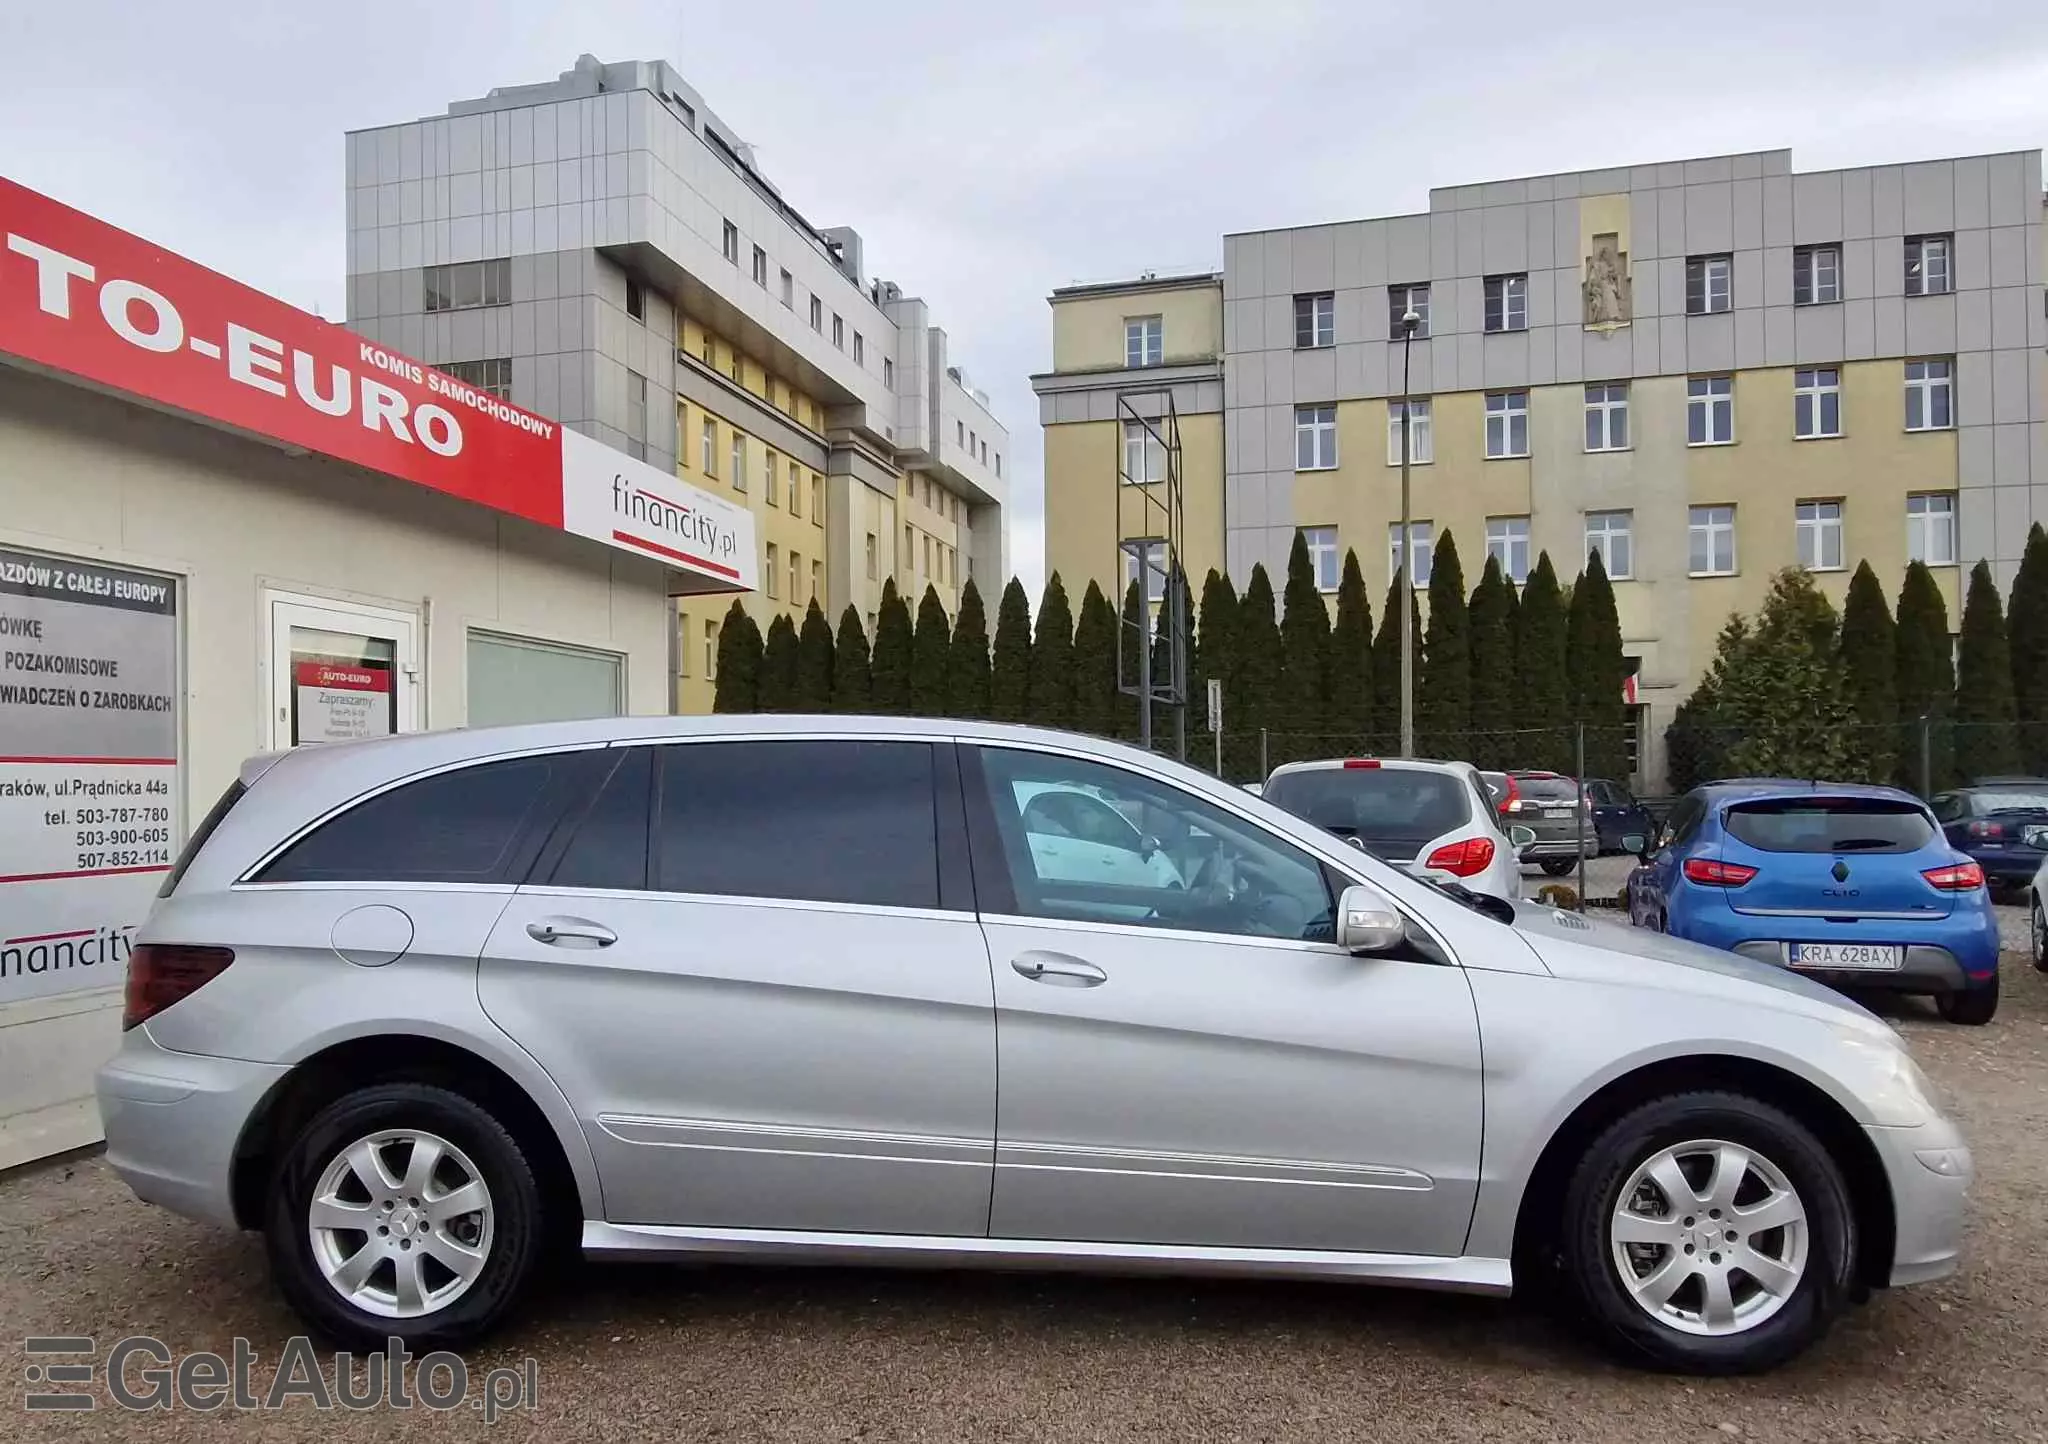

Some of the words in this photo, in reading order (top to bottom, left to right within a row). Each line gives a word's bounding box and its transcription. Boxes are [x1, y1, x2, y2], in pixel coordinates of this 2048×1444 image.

[8, 232, 463, 456] TO-EURO
[360, 343, 422, 385] KOMIS
[428, 370, 552, 440] SAMOCHODOWY
[613, 474, 736, 558] financity.pl
[54, 570, 63, 589] Z
[67, 572, 111, 596] CAŁEJ
[115, 580, 167, 604] EUROPY
[5, 651, 118, 677] POZAKOMISOWE
[323, 671, 372, 684] AUTO-EURO
[80, 691, 90, 707] O
[94, 691, 171, 712] ZAROBKACH
[0, 779, 50, 798] raków,
[55, 779, 142, 800] ul.Prądnicka
[146, 780, 168, 795] 44a
[45, 810, 70, 825] tel.
[76, 807, 169, 824] 503-787-780
[76, 828, 169, 846] 503-900-605
[78, 849, 169, 868] 507-852-114
[1822, 889, 1860, 897] CLIO
[1800, 946, 1832, 961] KRA
[1840, 947, 1892, 963] 628AX
